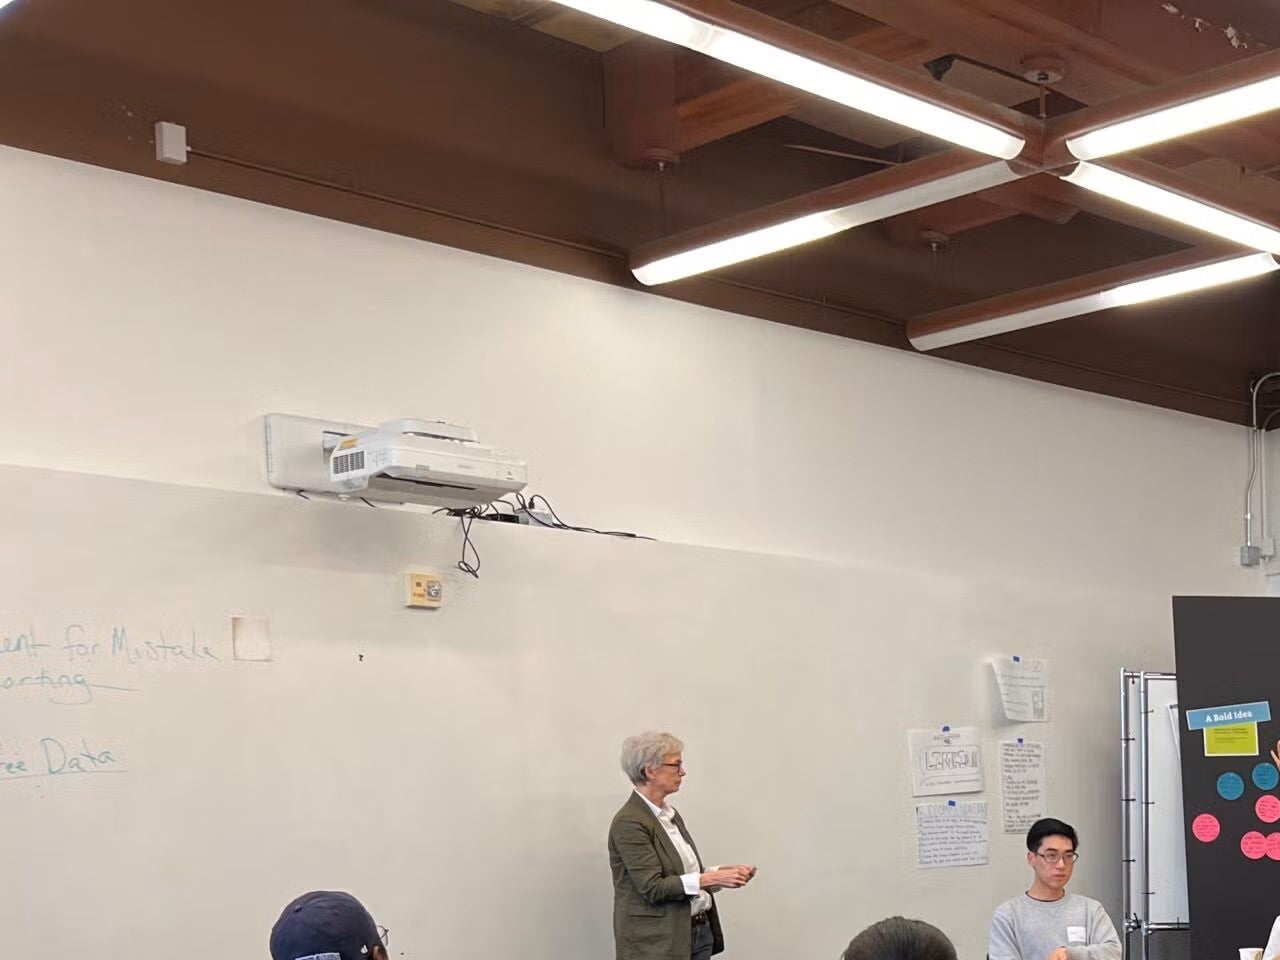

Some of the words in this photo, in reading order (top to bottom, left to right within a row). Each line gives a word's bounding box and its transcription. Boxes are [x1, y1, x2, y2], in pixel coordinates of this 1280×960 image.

[63, 624, 100, 661] for
[1213, 712, 1232, 722] Bold
[1233, 710, 1253, 719] Idea
[40, 737, 116, 774] Data
